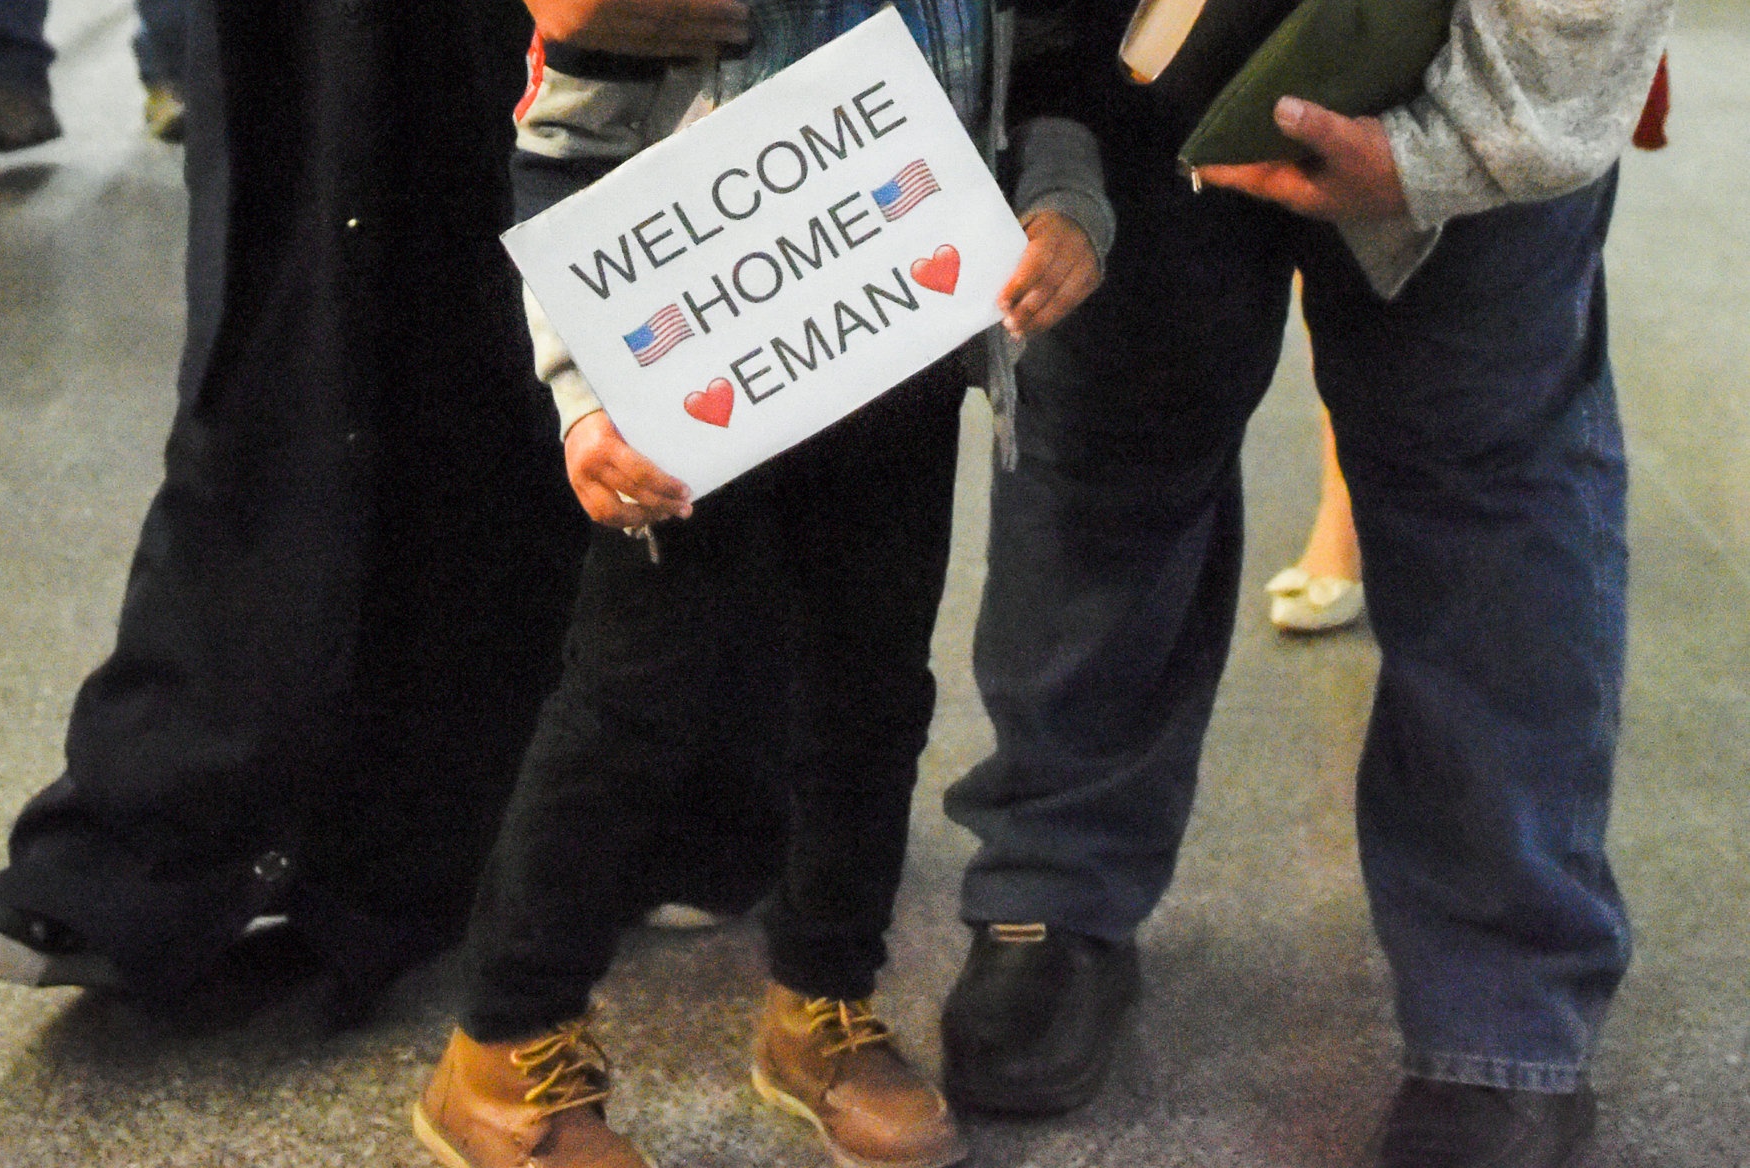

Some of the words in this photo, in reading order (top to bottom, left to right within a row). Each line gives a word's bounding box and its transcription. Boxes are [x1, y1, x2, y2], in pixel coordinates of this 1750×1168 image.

[569, 81, 908, 300] WELCOME
[682, 192, 882, 334] HOME
[728, 268, 921, 405] EMAN
